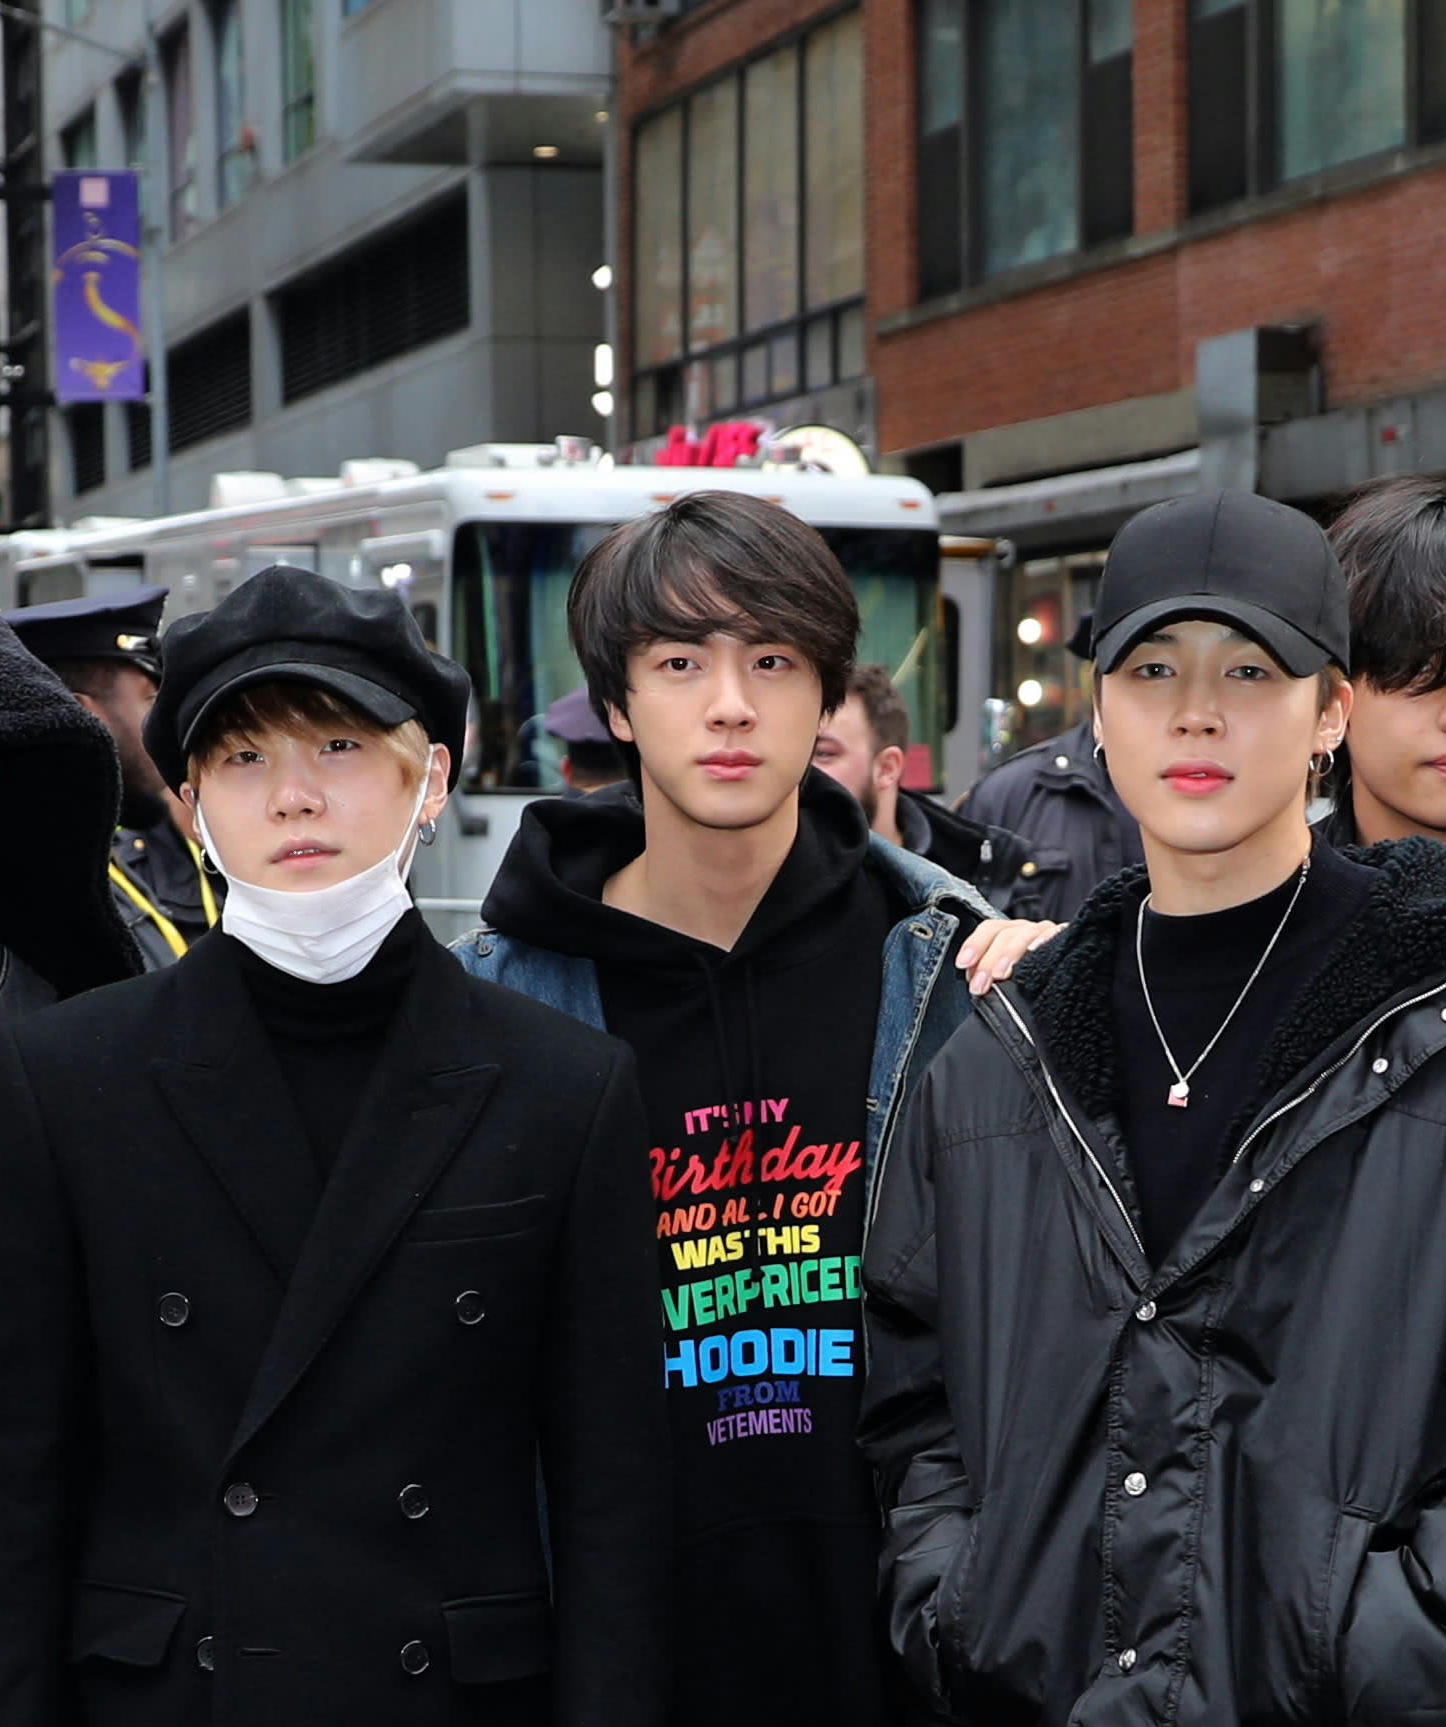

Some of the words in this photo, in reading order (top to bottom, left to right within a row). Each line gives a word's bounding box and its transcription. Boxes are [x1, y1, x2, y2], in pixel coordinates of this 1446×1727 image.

[657, 1202, 717, 1239] AND
[773, 1195, 782, 1219] I
[790, 1189, 842, 1220] GOT
[671, 1238, 744, 1271] WAS
[661, 1255, 862, 1332] VERPRICED
[664, 1328, 854, 1389] HOODIE
[717, 1380, 800, 1411] FROM
[706, 1407, 813, 1447] VETEMENTS
